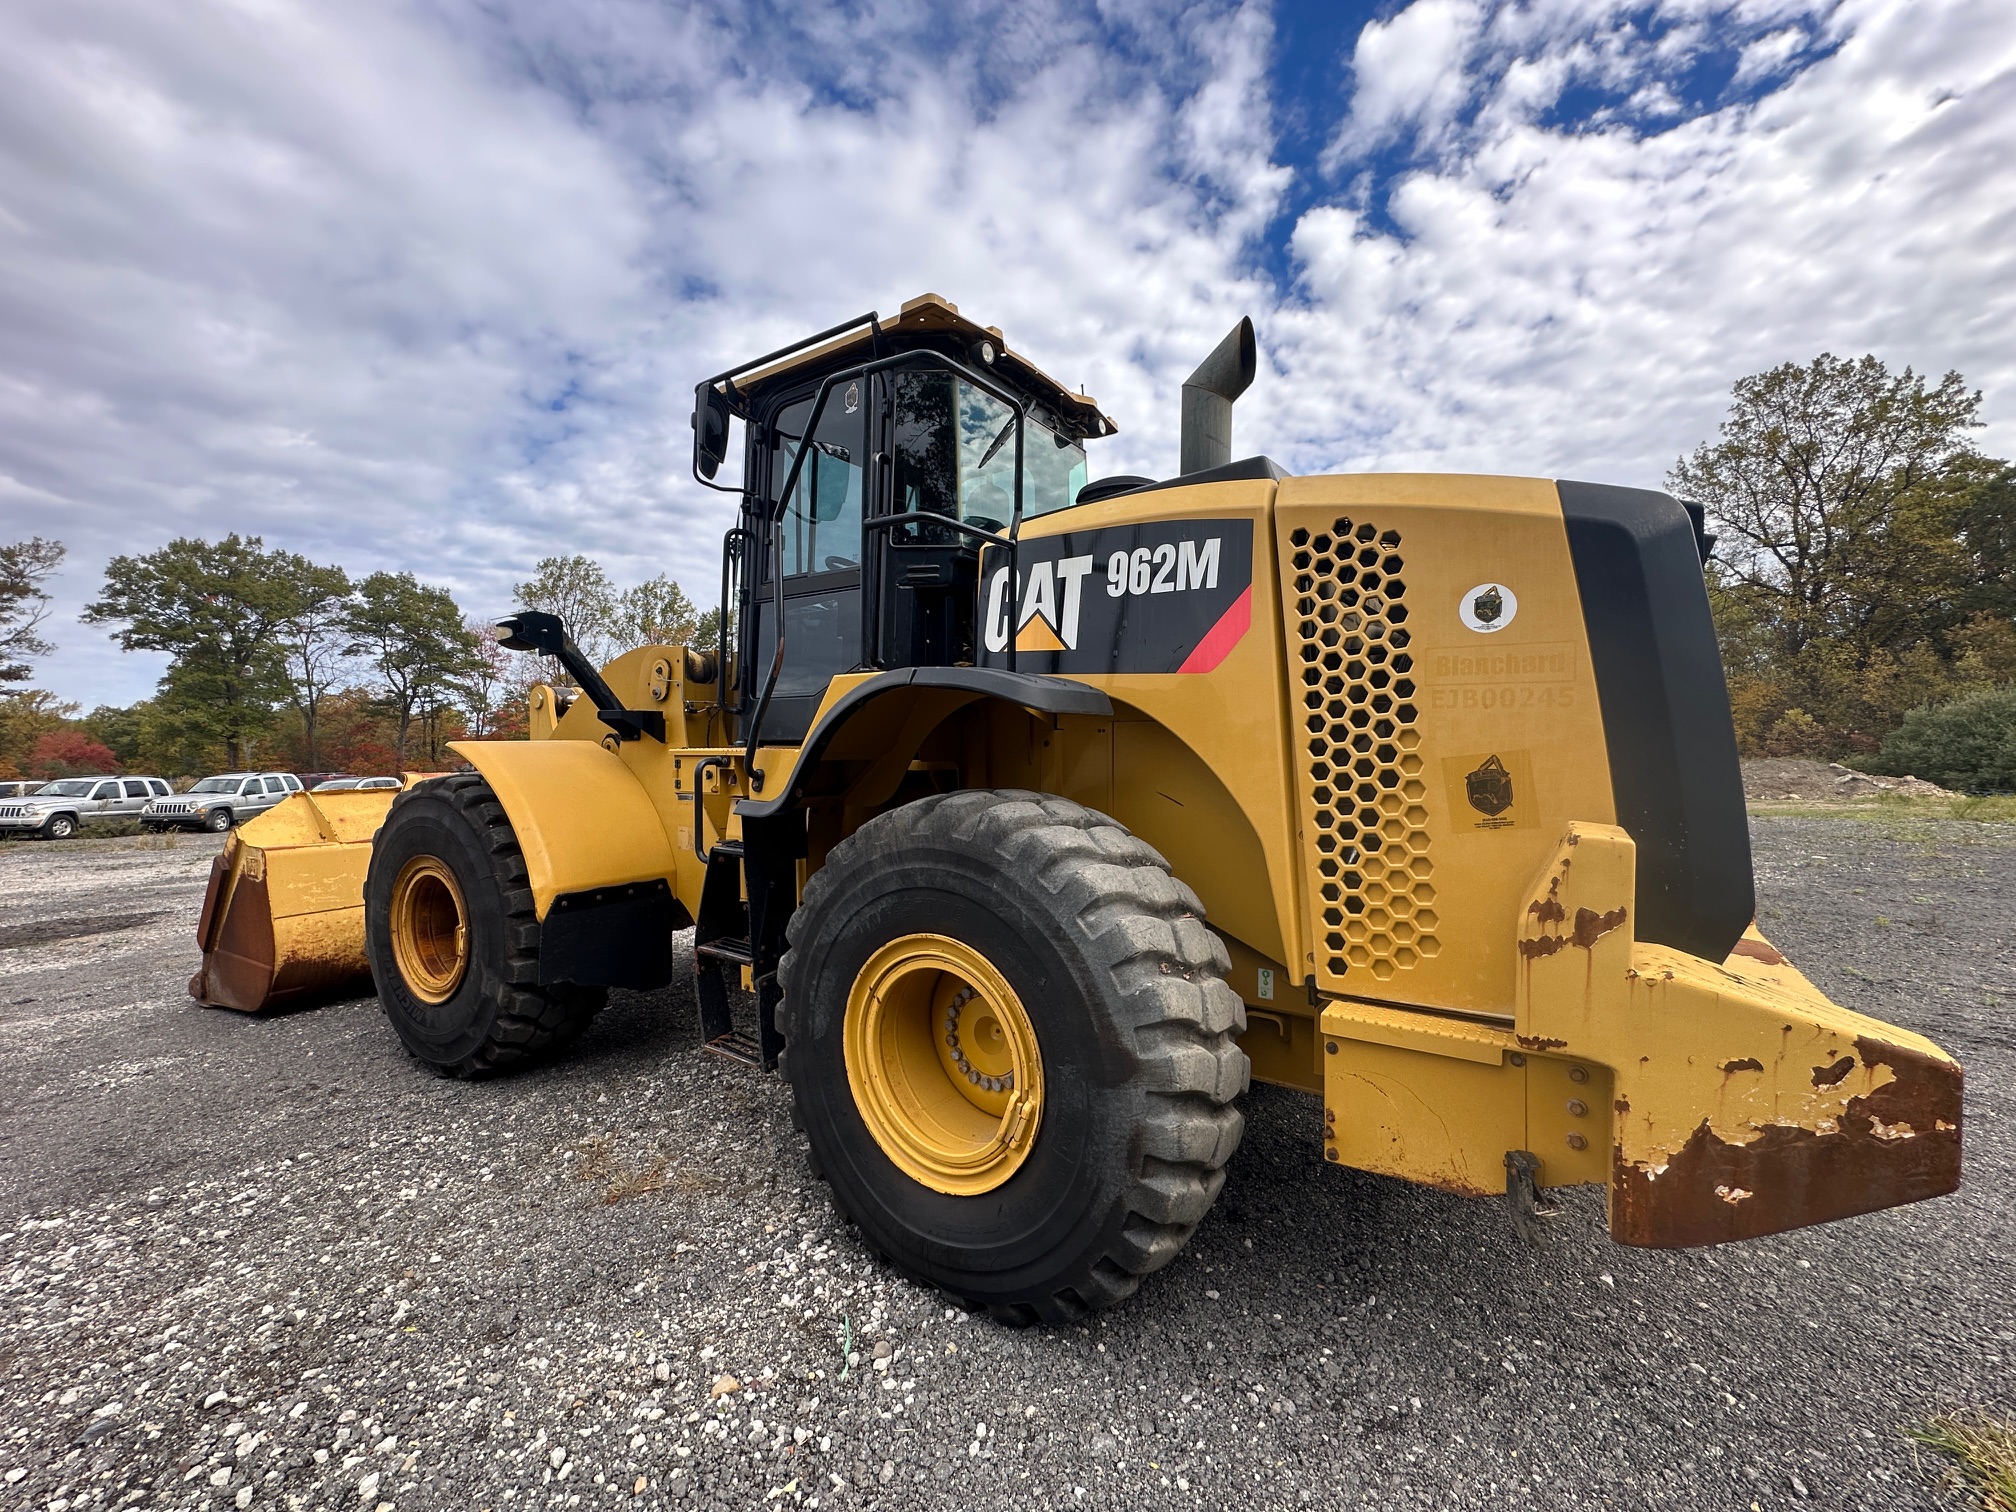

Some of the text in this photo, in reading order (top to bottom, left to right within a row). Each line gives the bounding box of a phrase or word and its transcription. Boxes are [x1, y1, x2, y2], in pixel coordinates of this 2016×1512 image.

[984, 537, 1222, 653] CAT 962M
[1436, 652, 1565, 677] Blanchard
[1431, 687, 1575, 709] EJB00245
